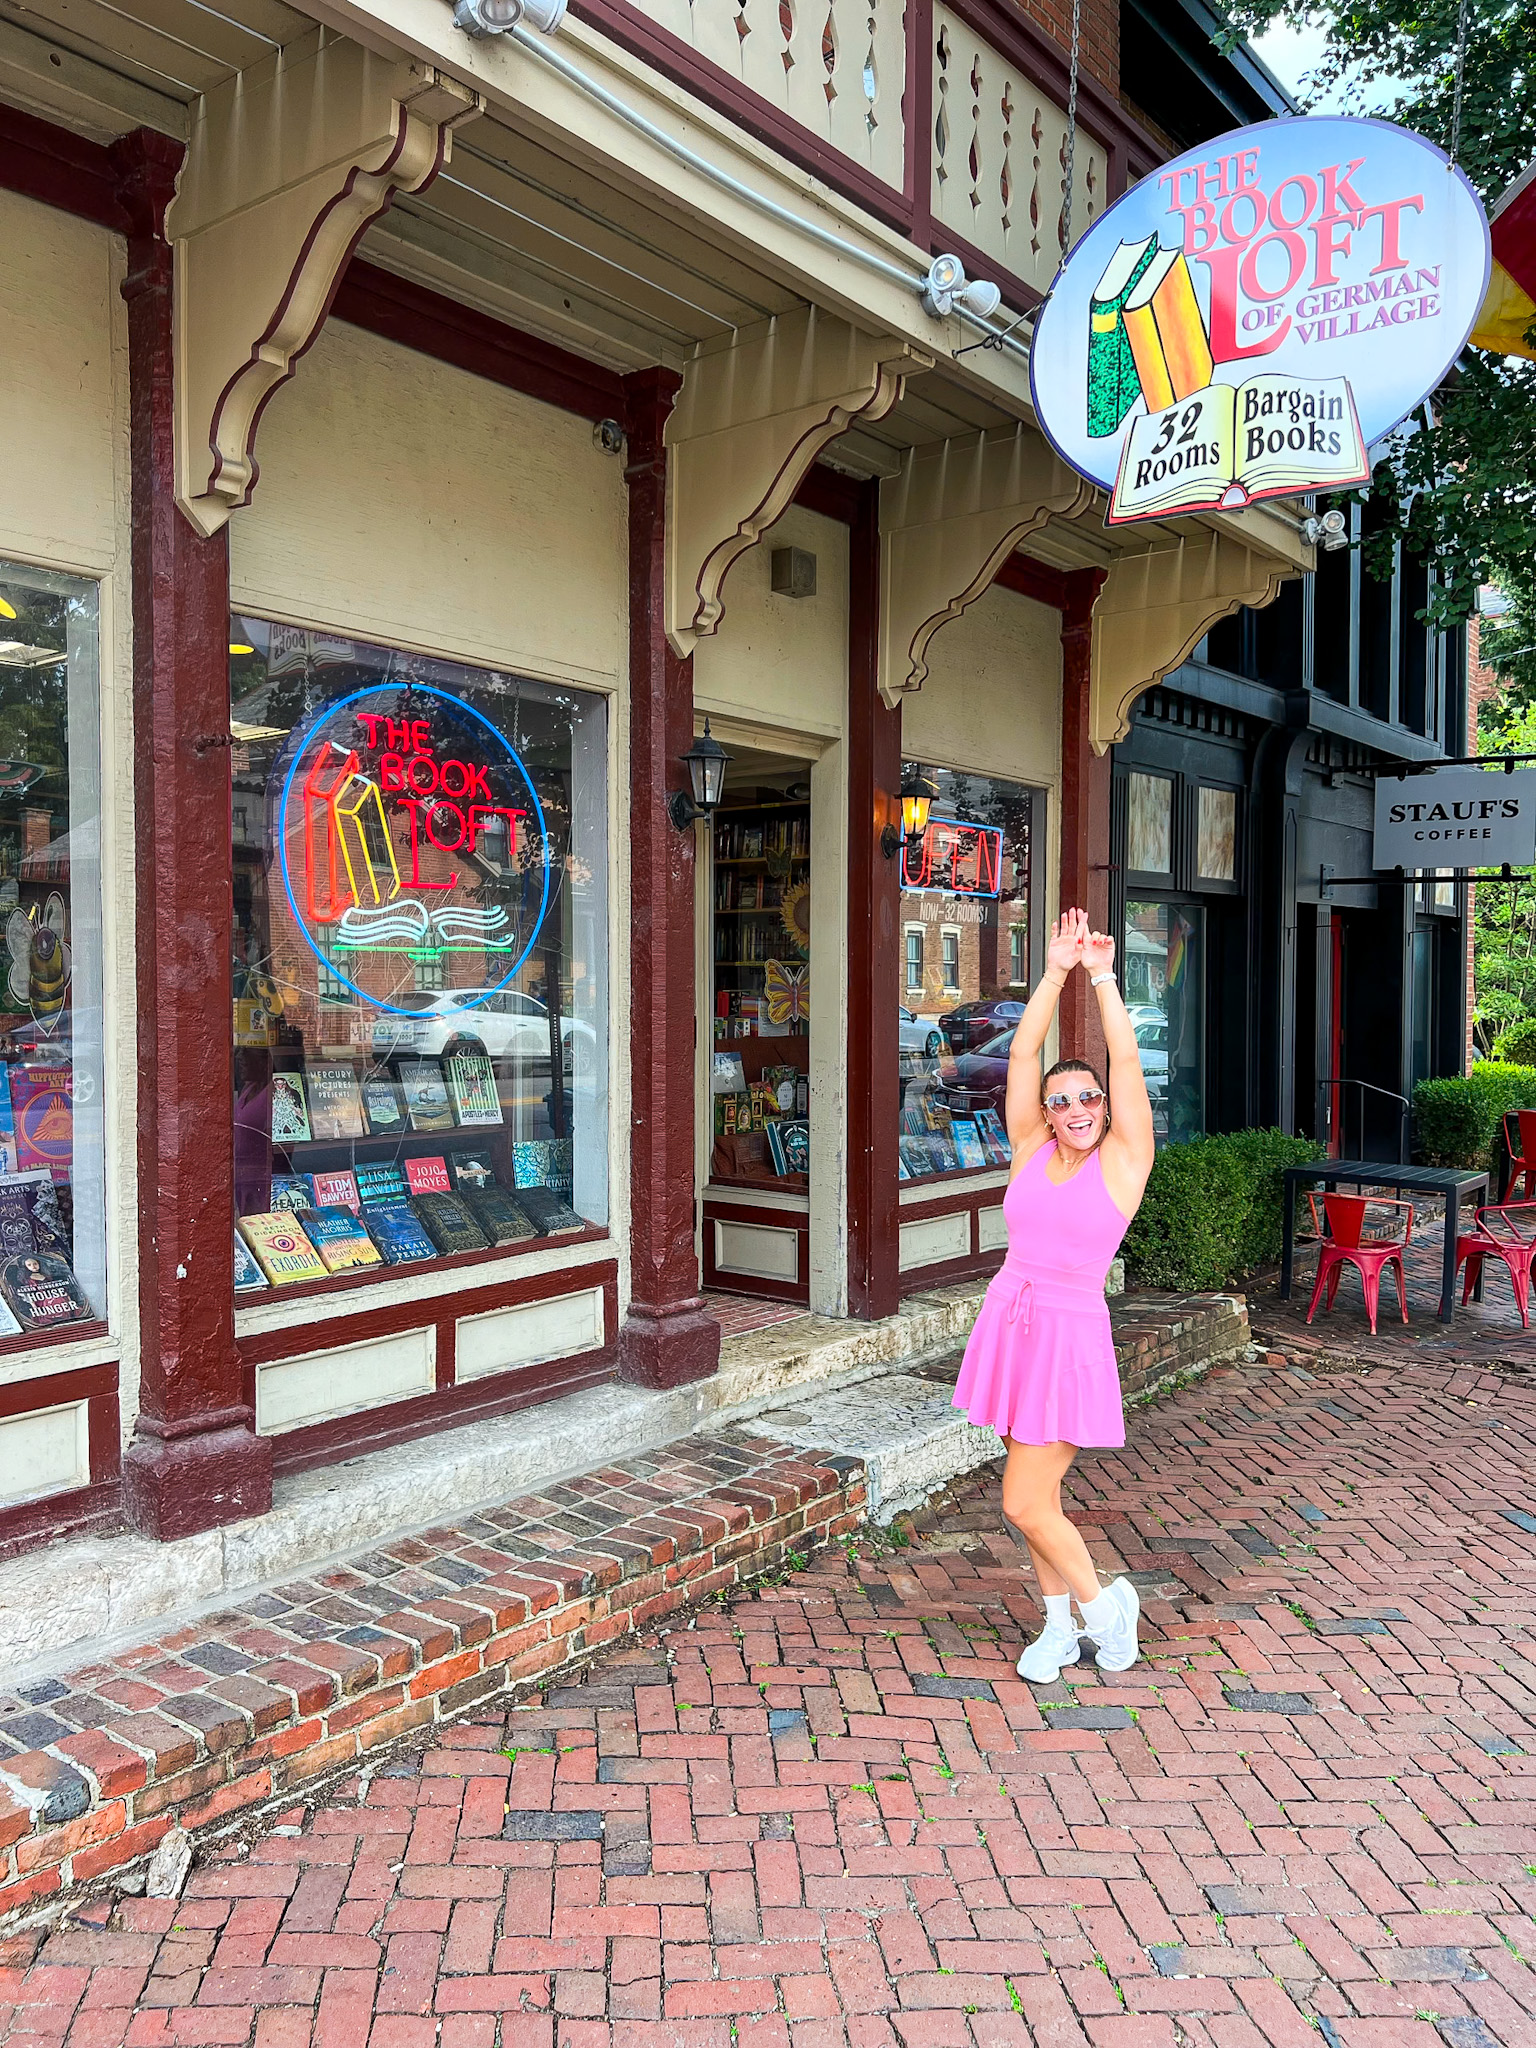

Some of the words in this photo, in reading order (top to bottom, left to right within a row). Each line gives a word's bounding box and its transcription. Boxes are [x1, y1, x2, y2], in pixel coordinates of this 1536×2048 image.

[1159, 147, 1263, 214] THE
[1179, 156, 1369, 256] BOOK
[1195, 194, 1424, 365] LOFT
[1242, 302, 1285, 331] OF
[1296, 264, 1443, 319] GERMAN
[1294, 293, 1442, 345] VILLAGE
[1243, 387, 1343, 424] Bargain
[1151, 401, 1203, 455] 32
[1245, 420, 1342, 463] Books
[1134, 441, 1220, 490] Rooms
[357, 713, 433, 755] THE
[380, 753, 492, 800] BOOK
[1389, 799, 1519, 823] STAUF'S
[1414, 828, 1491, 841] COFFEE
[397, 799, 527, 889] LOFT
[903, 823, 1000, 893] OPEN
[310, 1070, 352, 1079] MERCURY
[314, 1081, 352, 1089] PICTURES
[367, 1170, 392, 1183] LISA
[416, 1165, 440, 1177] JOJO
[9, 1184, 31, 1195] ARTS
[327, 1178, 353, 1193] TOM
[413, 1176, 448, 1189] MOYES
[321, 1190, 356, 1203] SAWYER
[254, 1227, 300, 1236] DICKINSON
[317, 1218, 350, 1229] HEATHER
[321, 1225, 354, 1235] MORRIS
[327, 1248, 358, 1259] RISING
[357, 1246, 375, 1255] SUN
[391, 1241, 428, 1251] SARAH
[397, 1248, 431, 1259] PERRY
[270, 1252, 321, 1273] EXORDIA
[26, 1287, 67, 1303] HOUSE
[29, 1301, 80, 1318] HUNGER
